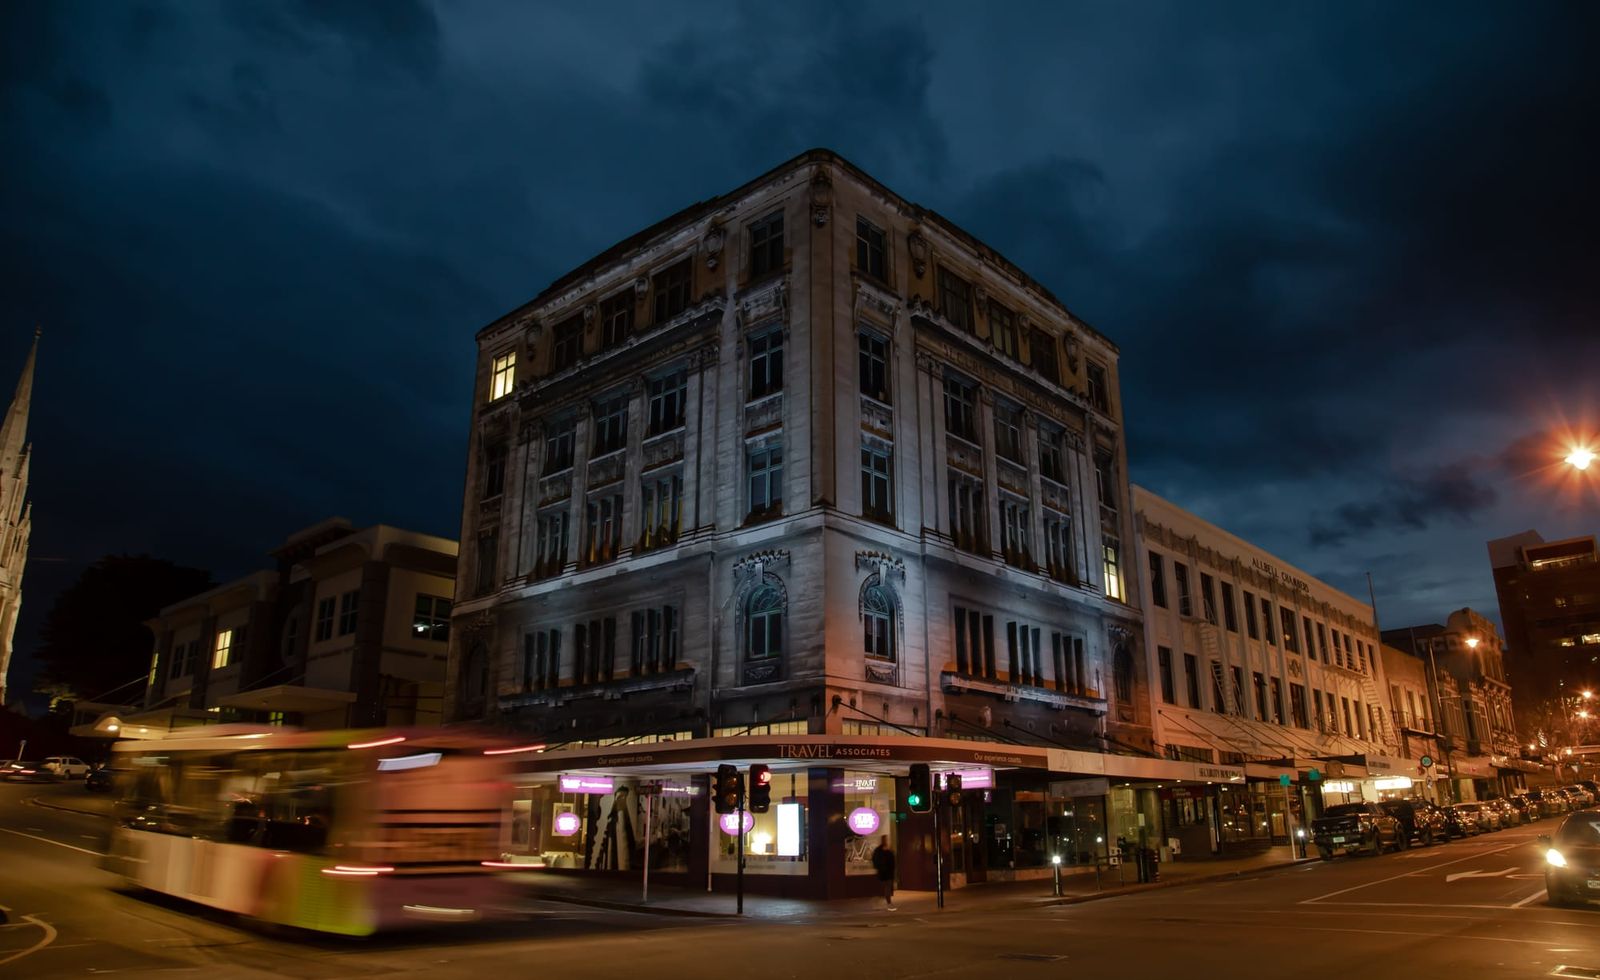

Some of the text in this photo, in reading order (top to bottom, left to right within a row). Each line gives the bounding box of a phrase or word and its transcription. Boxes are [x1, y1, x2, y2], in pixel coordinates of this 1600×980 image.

[1252, 558, 1309, 592] ALLBELL CHAMBERS
[777, 744, 891, 758] TRAVEL ASSOCIATES
